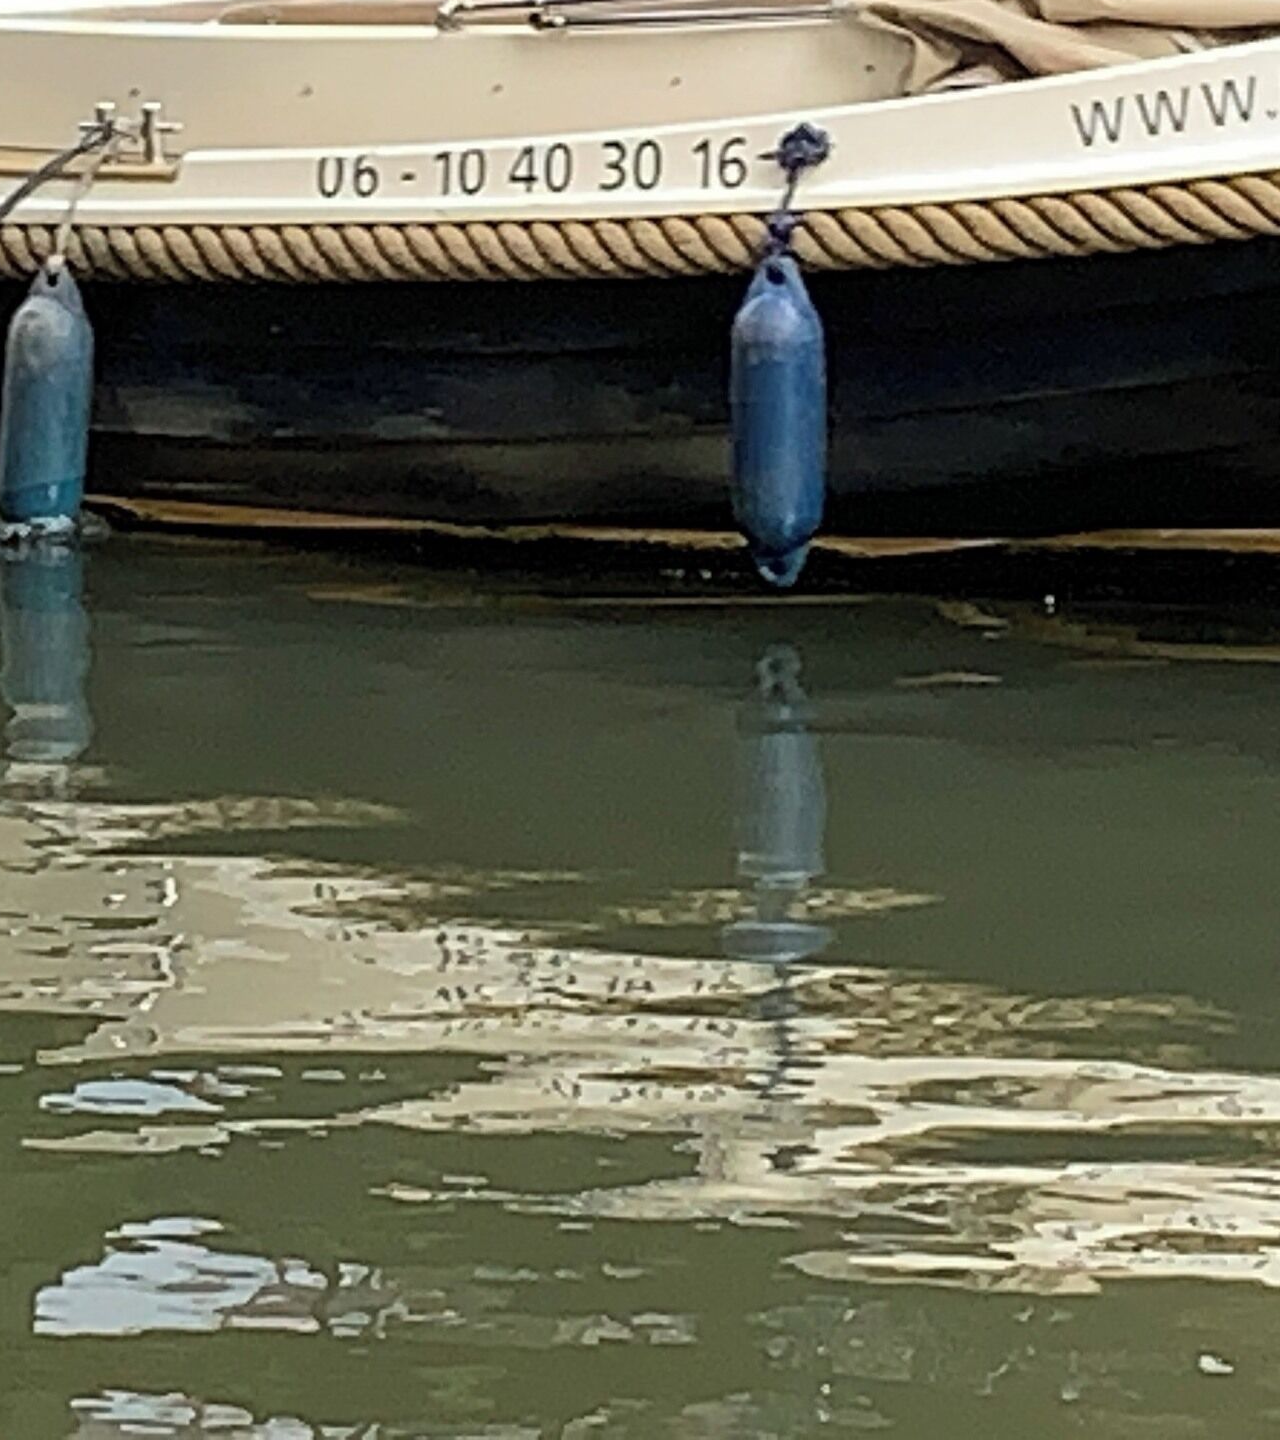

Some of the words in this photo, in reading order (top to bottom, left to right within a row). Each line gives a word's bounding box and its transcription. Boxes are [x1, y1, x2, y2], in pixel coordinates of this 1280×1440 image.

[316, 153, 379, 199] 06
[434, 147, 487, 197] 10
[508, 143, 573, 193] 40
[597, 139, 663, 191] 30
[691, 136, 748, 190] 16
